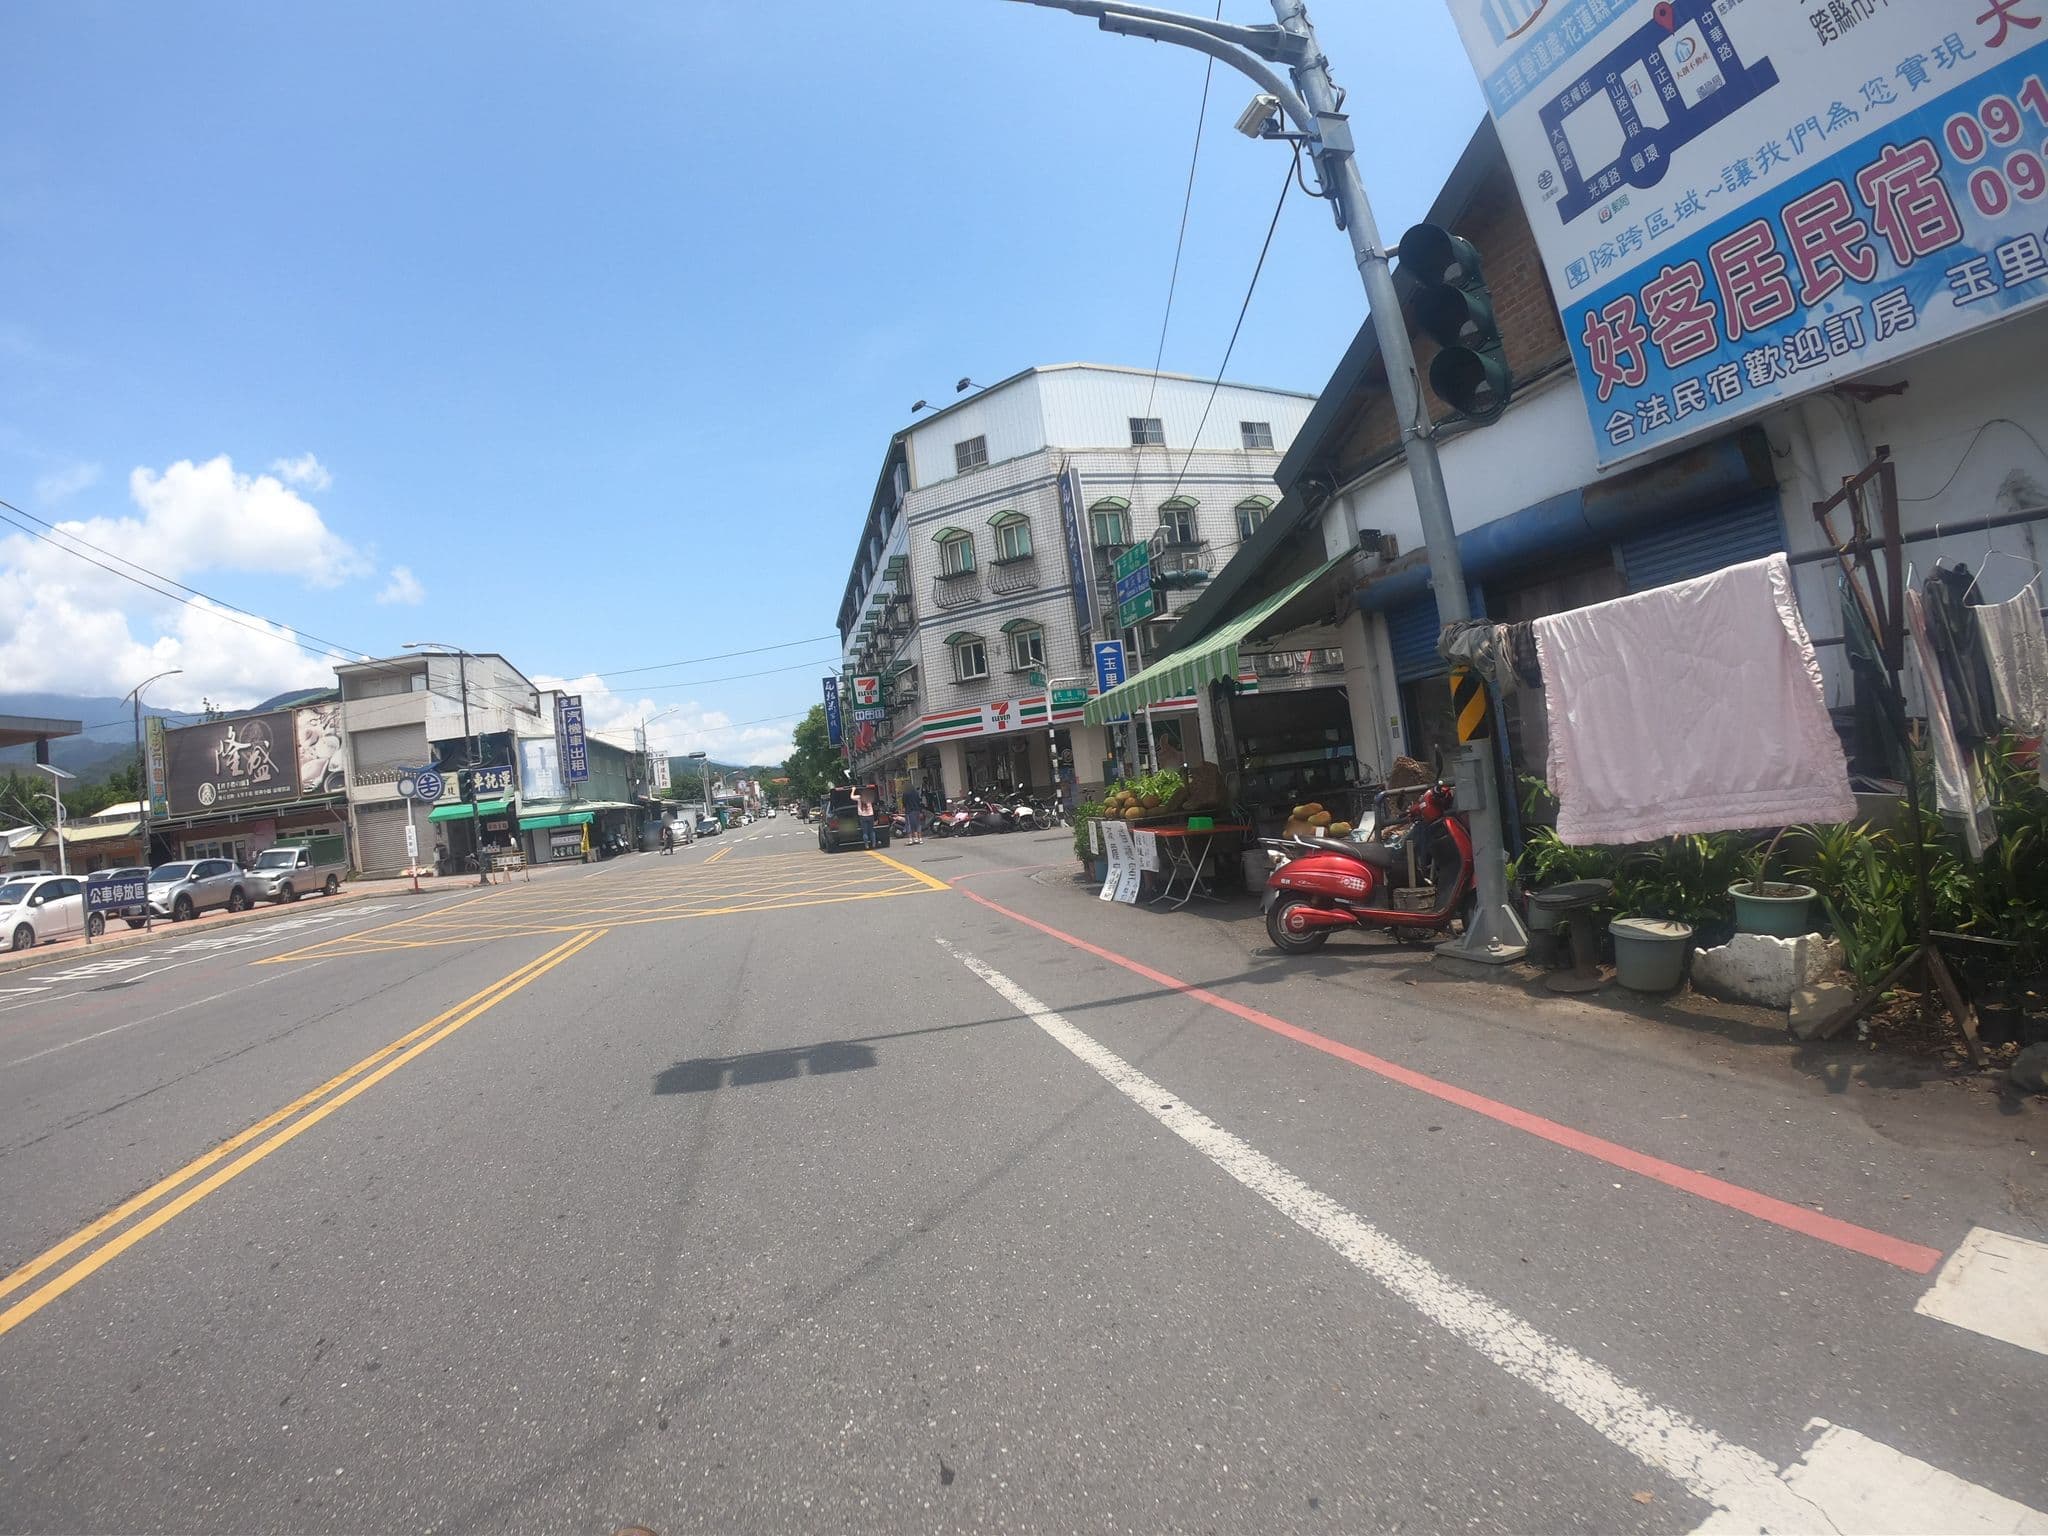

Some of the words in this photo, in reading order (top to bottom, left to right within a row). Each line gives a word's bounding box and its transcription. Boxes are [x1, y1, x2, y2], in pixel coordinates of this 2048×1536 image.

[1701, 11, 1733, 62] 中華路
[1560, 79, 1592, 112] 民權街
[1648, 51, 1677, 101] 中正路
[1606, 72, 1641, 138] 中山路二段
[1588, 167, 1622, 200] 光復路
[1967, 136, 2048, 219] 09
[1582, 138, 1963, 402] 好客居民宿
[1604, 285, 1917, 447] 合法民宿歡迎訂房
[1946, 230, 2048, 307] 玉里
[567, 710, 585, 772] 汽機車出租
[991, 714, 1011, 722] ELEVEN
[214, 724, 280, 783] 隆盛
[89, 880, 146, 905] 公車停放區
